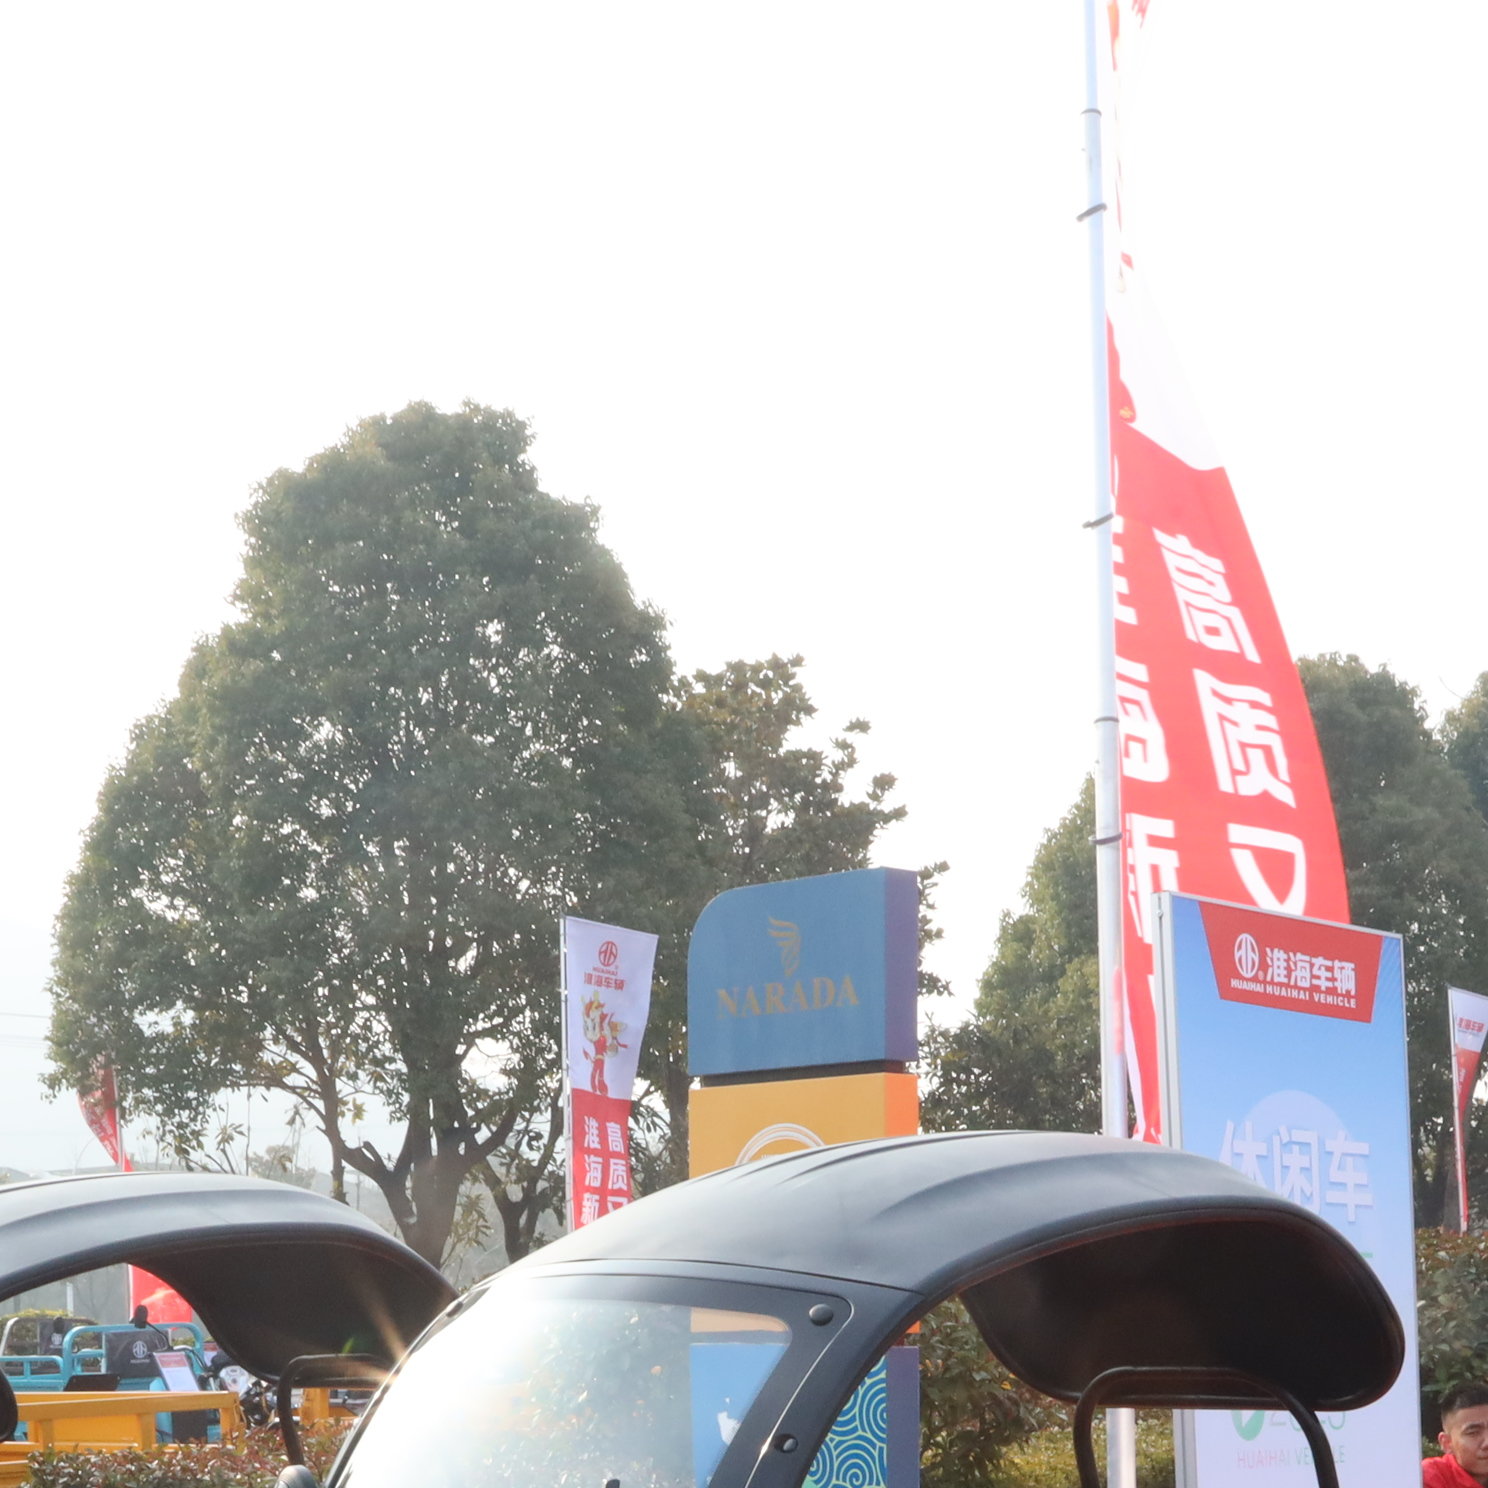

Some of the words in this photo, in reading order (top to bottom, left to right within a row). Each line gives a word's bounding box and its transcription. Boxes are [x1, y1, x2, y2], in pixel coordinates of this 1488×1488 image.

[1230, 978, 1264, 993] HUAIHAI
[1265, 946, 1357, 996] 淮海车辆
[716, 974, 860, 1020] NARADA
[1266, 983, 1310, 1001] HUAIHAI
[1313, 991, 1357, 1009] VEHICLE
[1218, 1120, 1374, 1223] 休闲车
[1237, 1451, 1291, 1471] HUAIHAI
